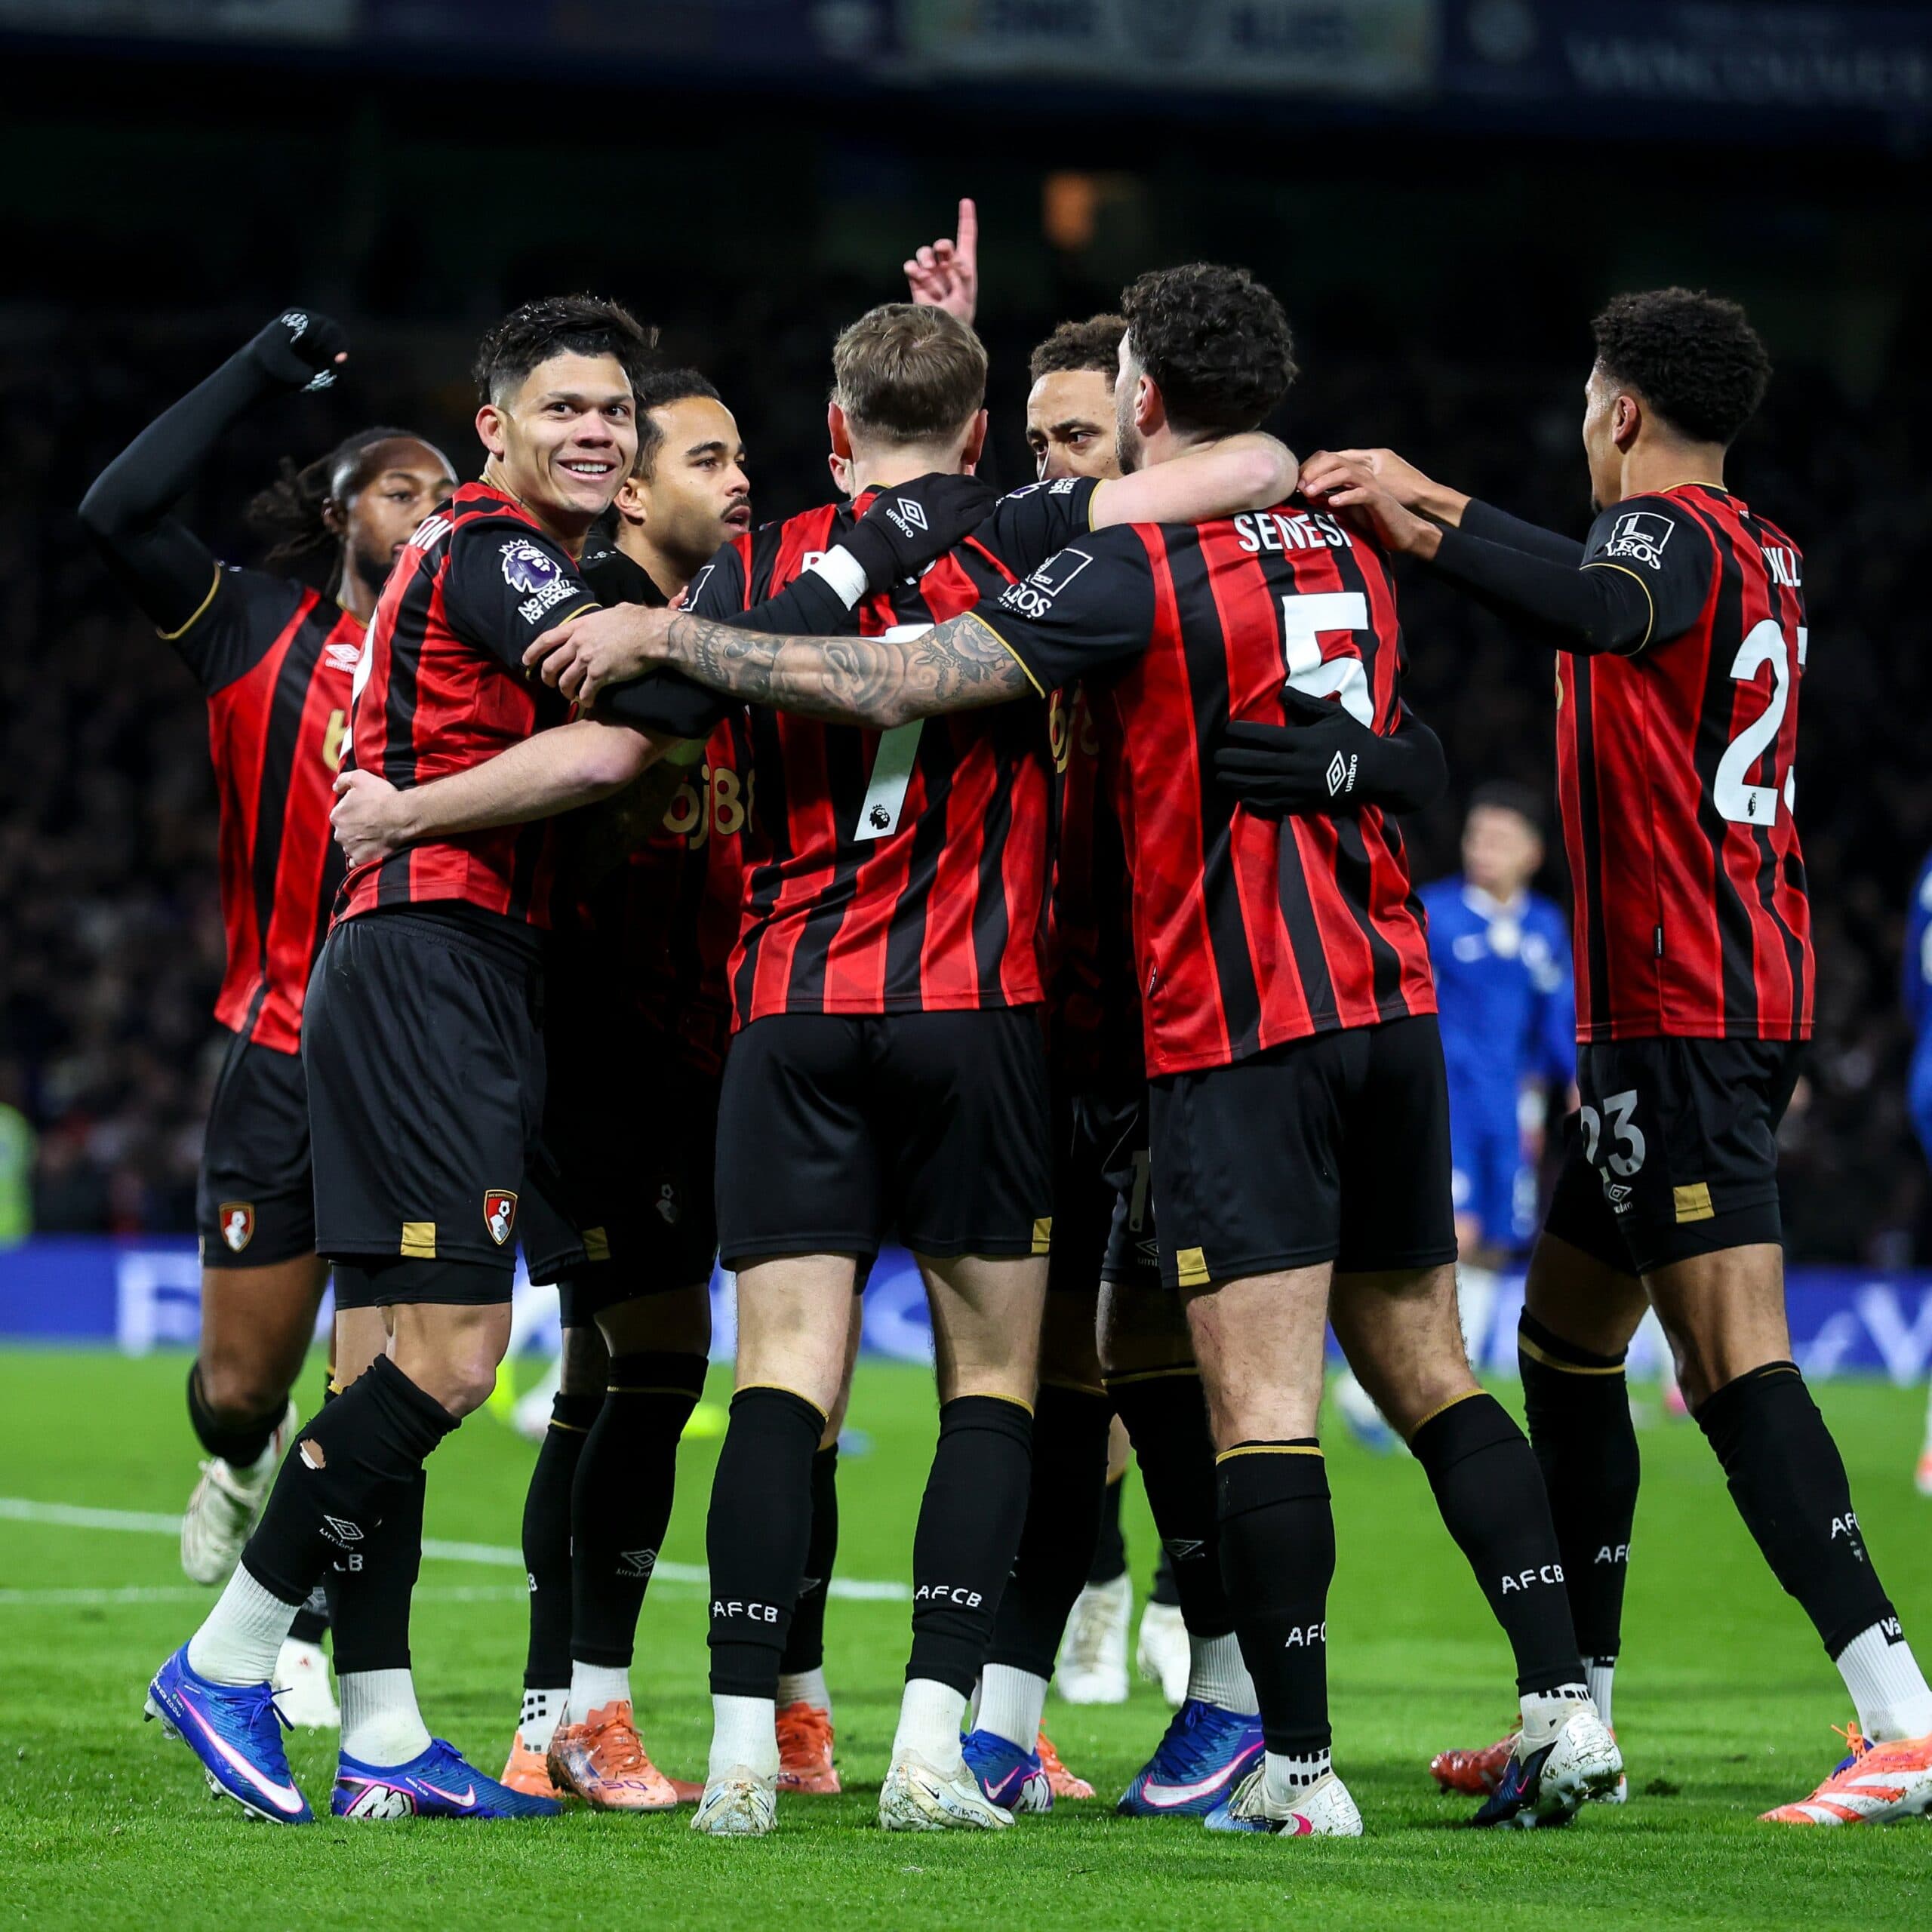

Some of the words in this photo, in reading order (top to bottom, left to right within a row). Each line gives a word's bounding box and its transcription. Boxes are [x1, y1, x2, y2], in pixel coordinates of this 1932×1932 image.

[885, 508, 914, 538] umbro
[1233, 513, 1353, 552] SENESI
[518, 598, 539, 617] No
[537, 580, 571, 601] room
[525, 605, 544, 625] for
[1281, 592, 1374, 729] 5
[854, 623, 935, 841] 7
[1713, 618, 1808, 827] 2
[1344, 754, 1358, 792] umbro
[1580, 1089, 1646, 1183] 23
[915, 1585, 983, 1607] AFCB
[1501, 1564, 1564, 1595] AFCB
[712, 1601, 778, 1623] AFCB
